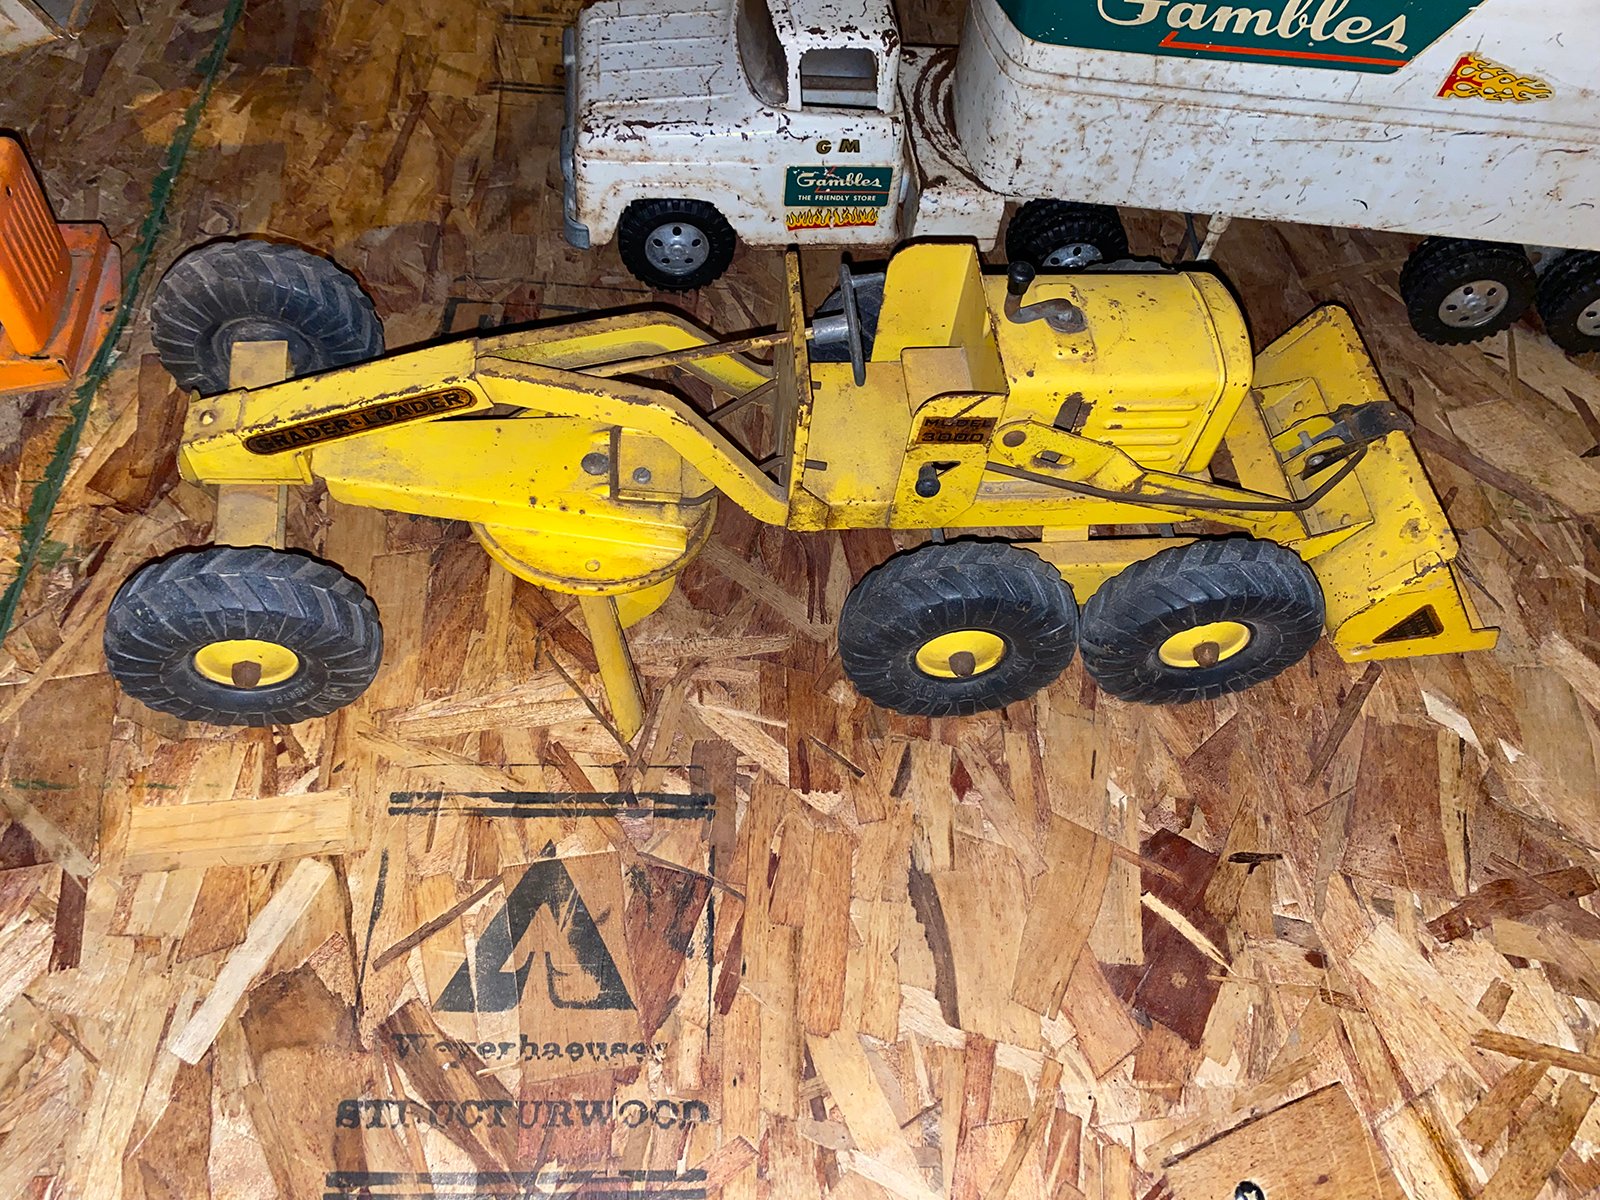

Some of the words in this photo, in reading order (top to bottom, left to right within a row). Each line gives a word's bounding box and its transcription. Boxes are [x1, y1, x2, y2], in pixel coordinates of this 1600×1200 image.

[1097, 0, 1408, 54] Gambles
[796, 172, 882, 188] Gambles
[798, 194, 812, 202] THE
[815, 194, 850, 202] FRIENDLY
[853, 194, 877, 202] STORE
[924, 418, 992, 428] MODEL
